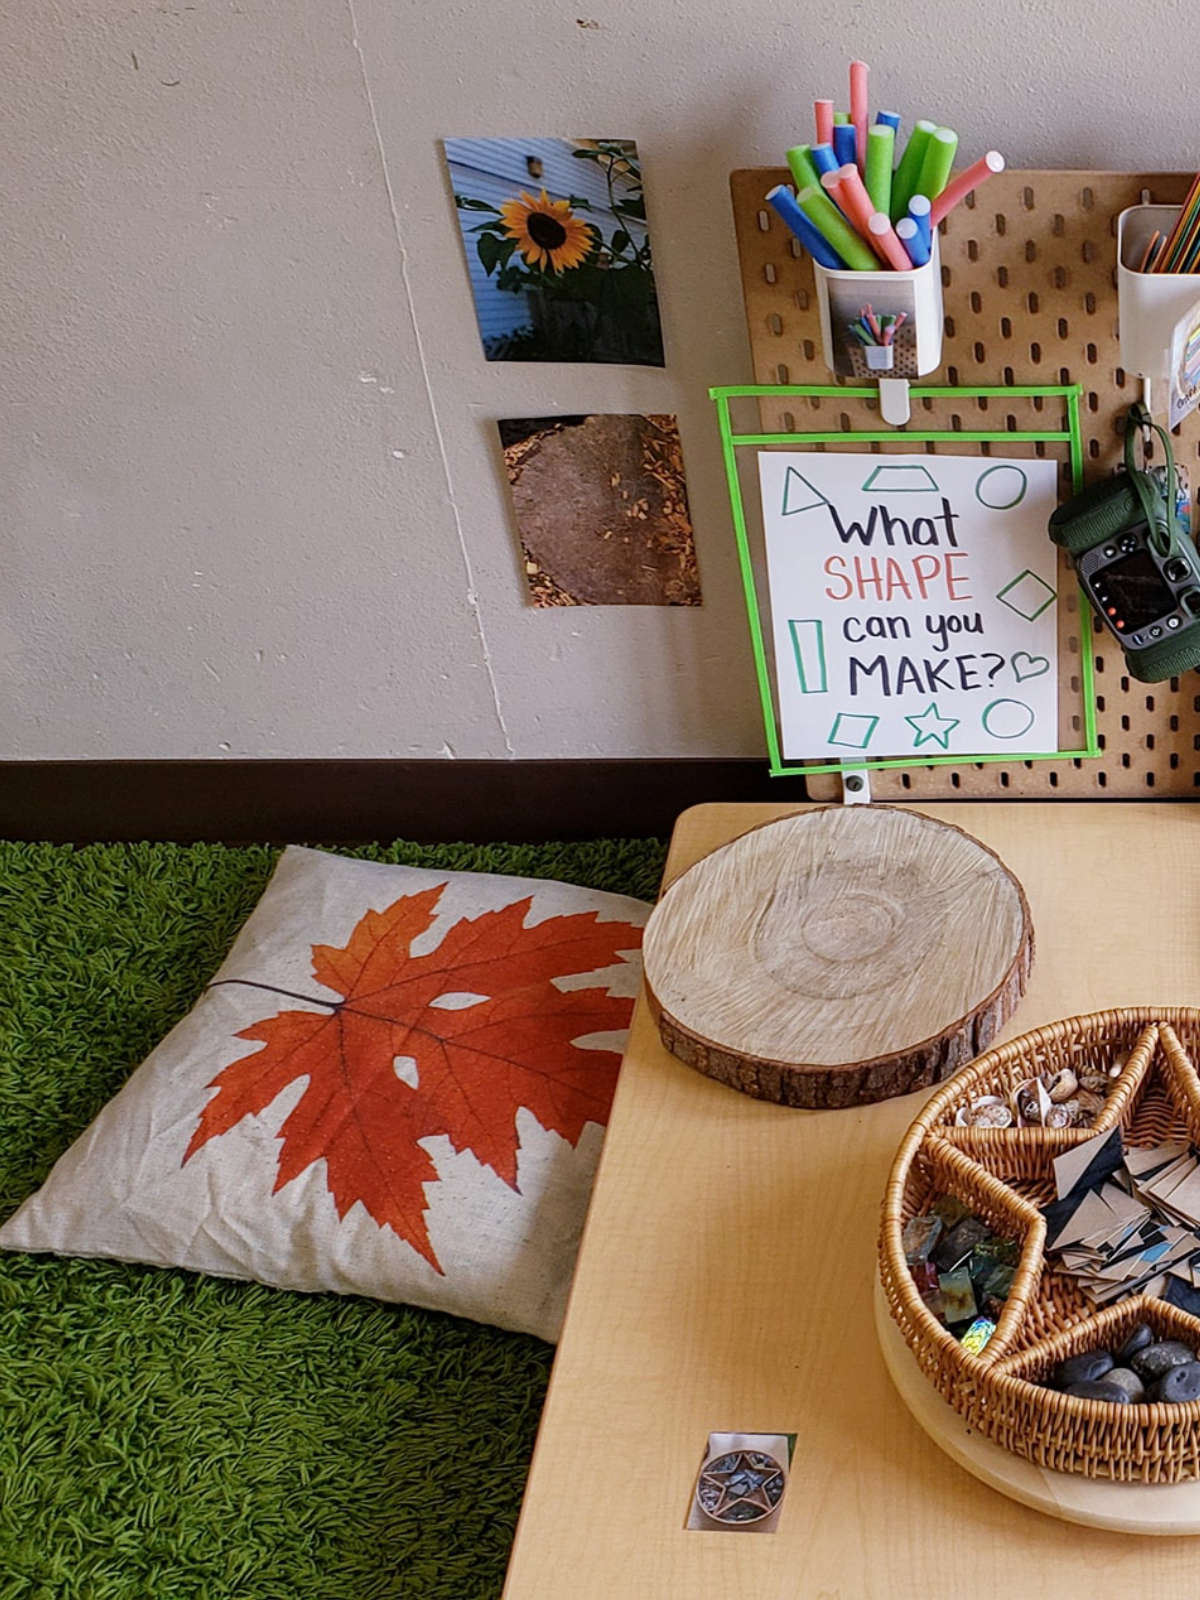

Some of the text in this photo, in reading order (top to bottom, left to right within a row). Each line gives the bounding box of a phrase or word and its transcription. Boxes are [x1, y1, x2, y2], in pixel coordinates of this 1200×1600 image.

[828, 497, 960, 547] What
[823, 552, 973, 602] SHAPE
[842, 612, 985, 653] can you
[849, 653, 1006, 696] MAKE?
